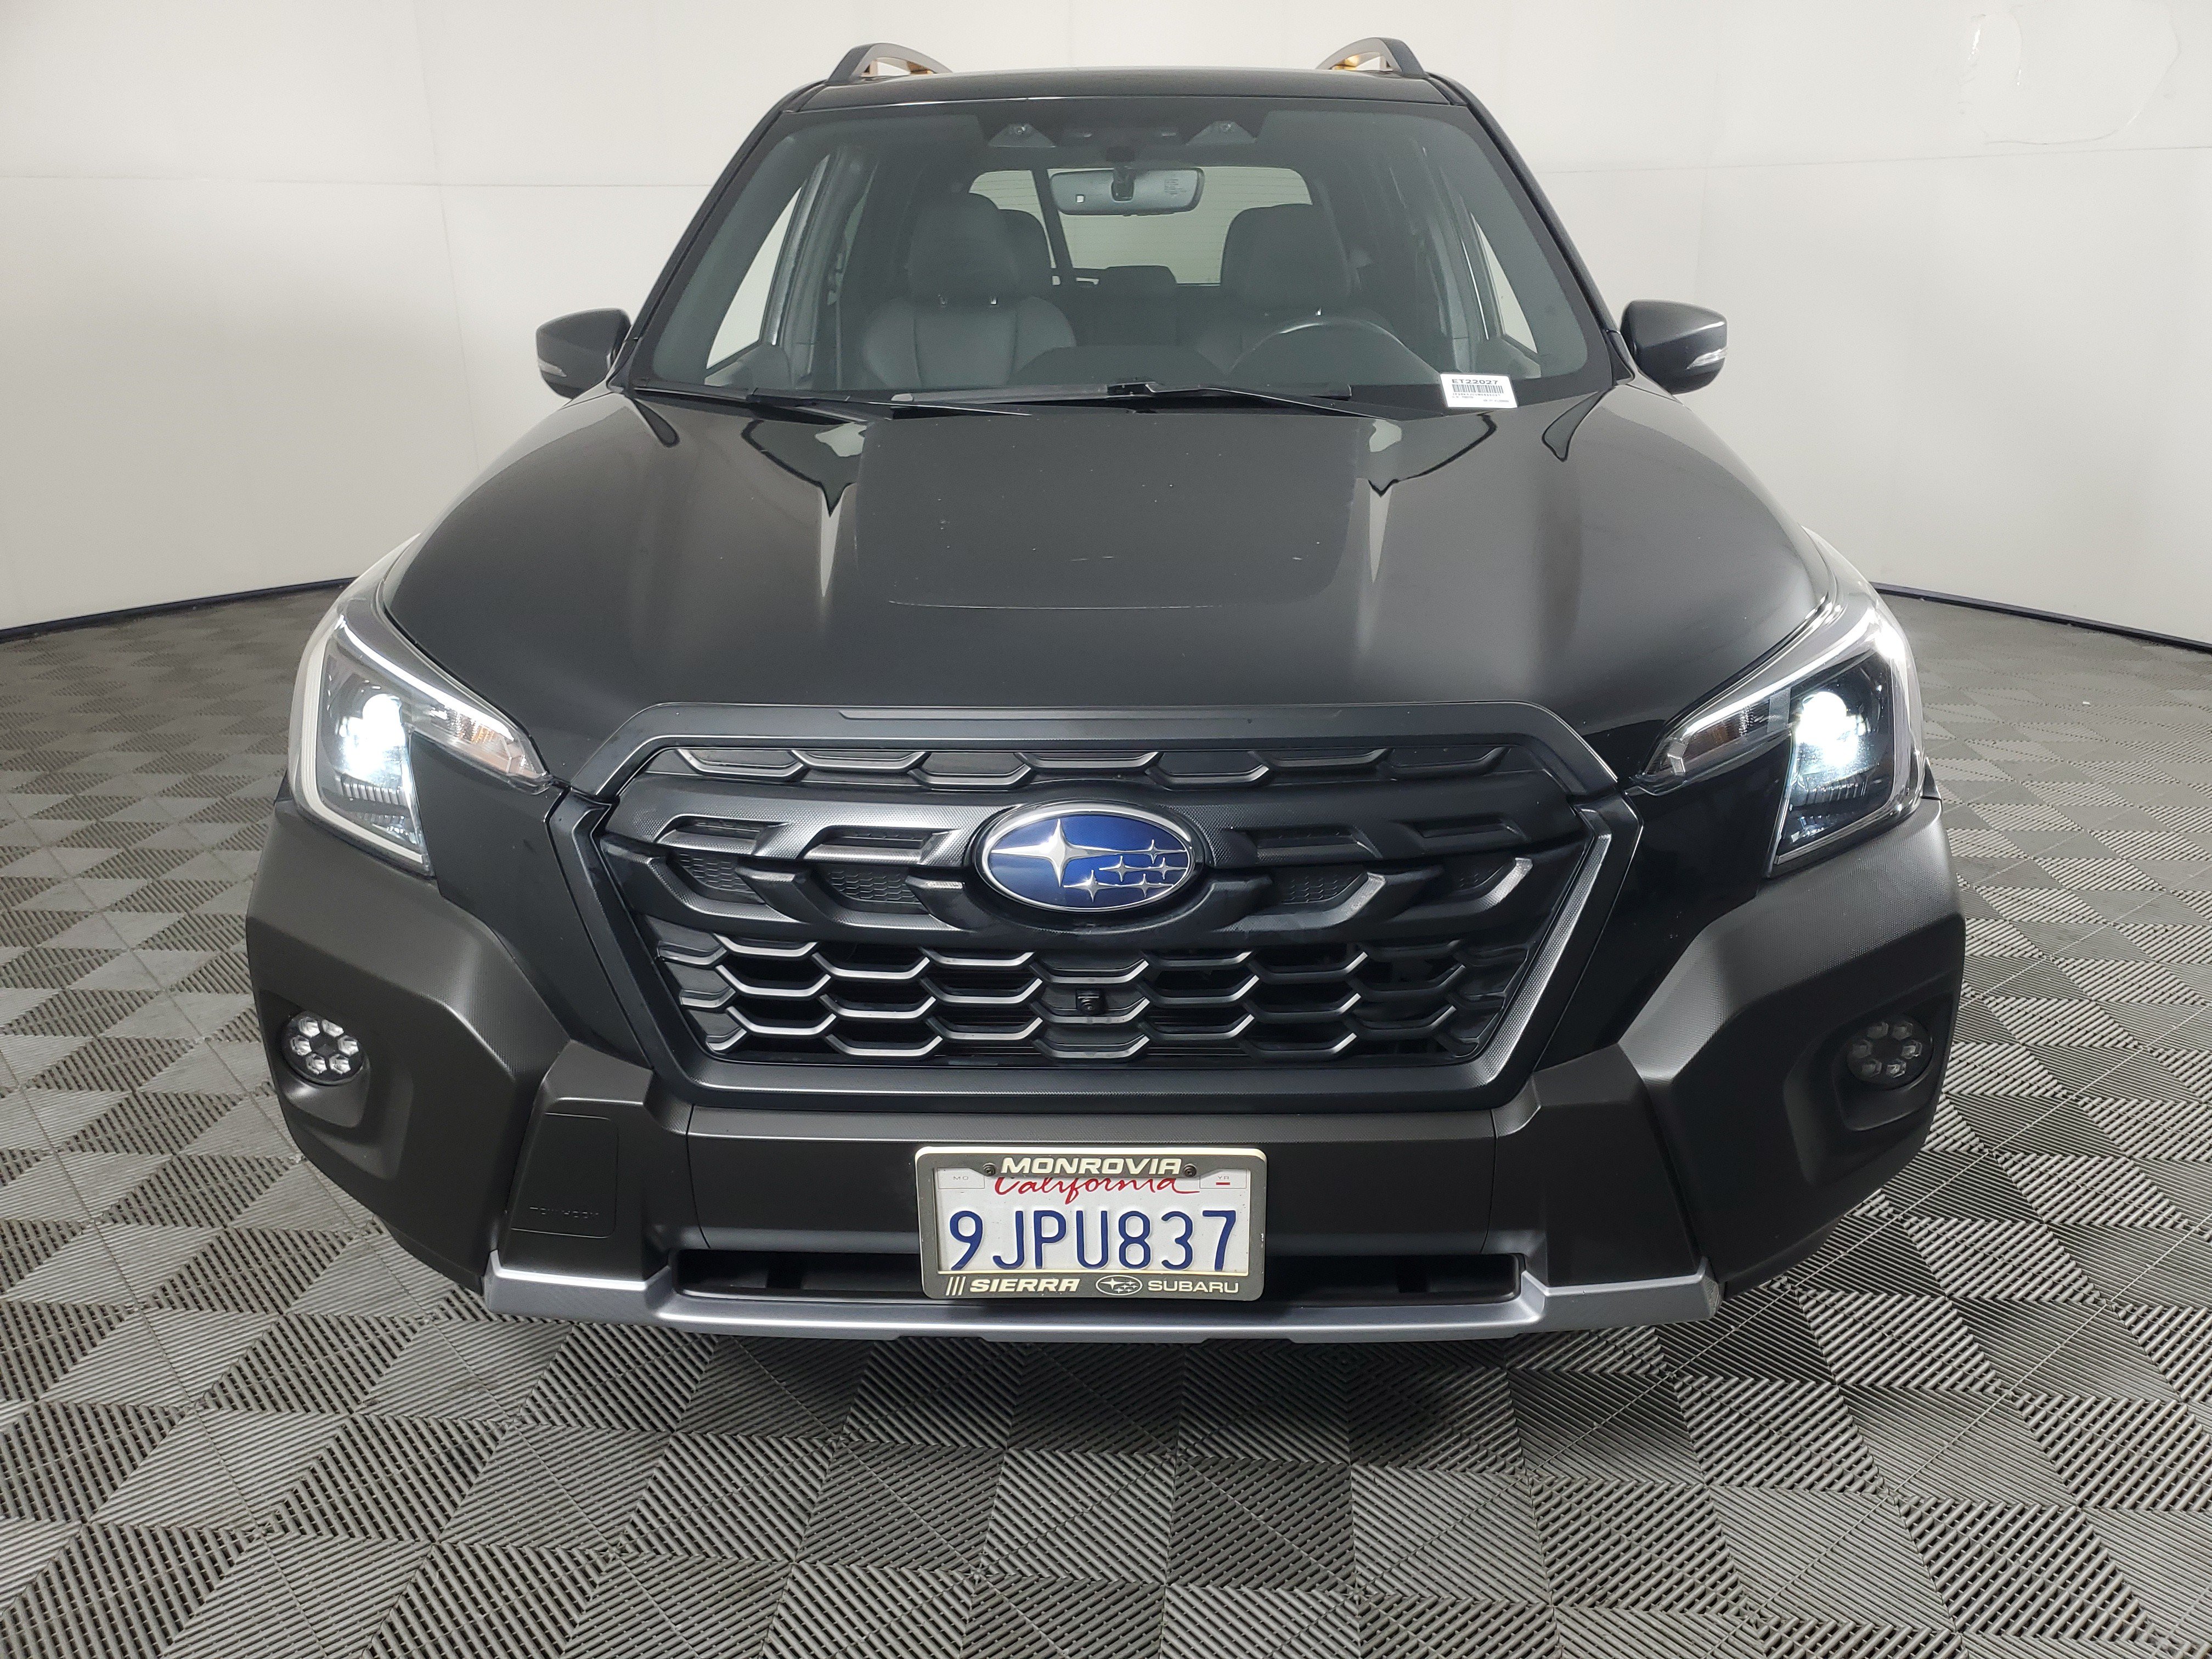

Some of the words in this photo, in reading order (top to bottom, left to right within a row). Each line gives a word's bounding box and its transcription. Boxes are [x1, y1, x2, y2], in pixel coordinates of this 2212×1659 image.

[1000, 1157, 1182, 1175] MONROVIA
[949, 1210, 1237, 1272] 9JPU837
[969, 1278, 1081, 1293] SIERRA
[1147, 1279, 1239, 1294] SUBARU
